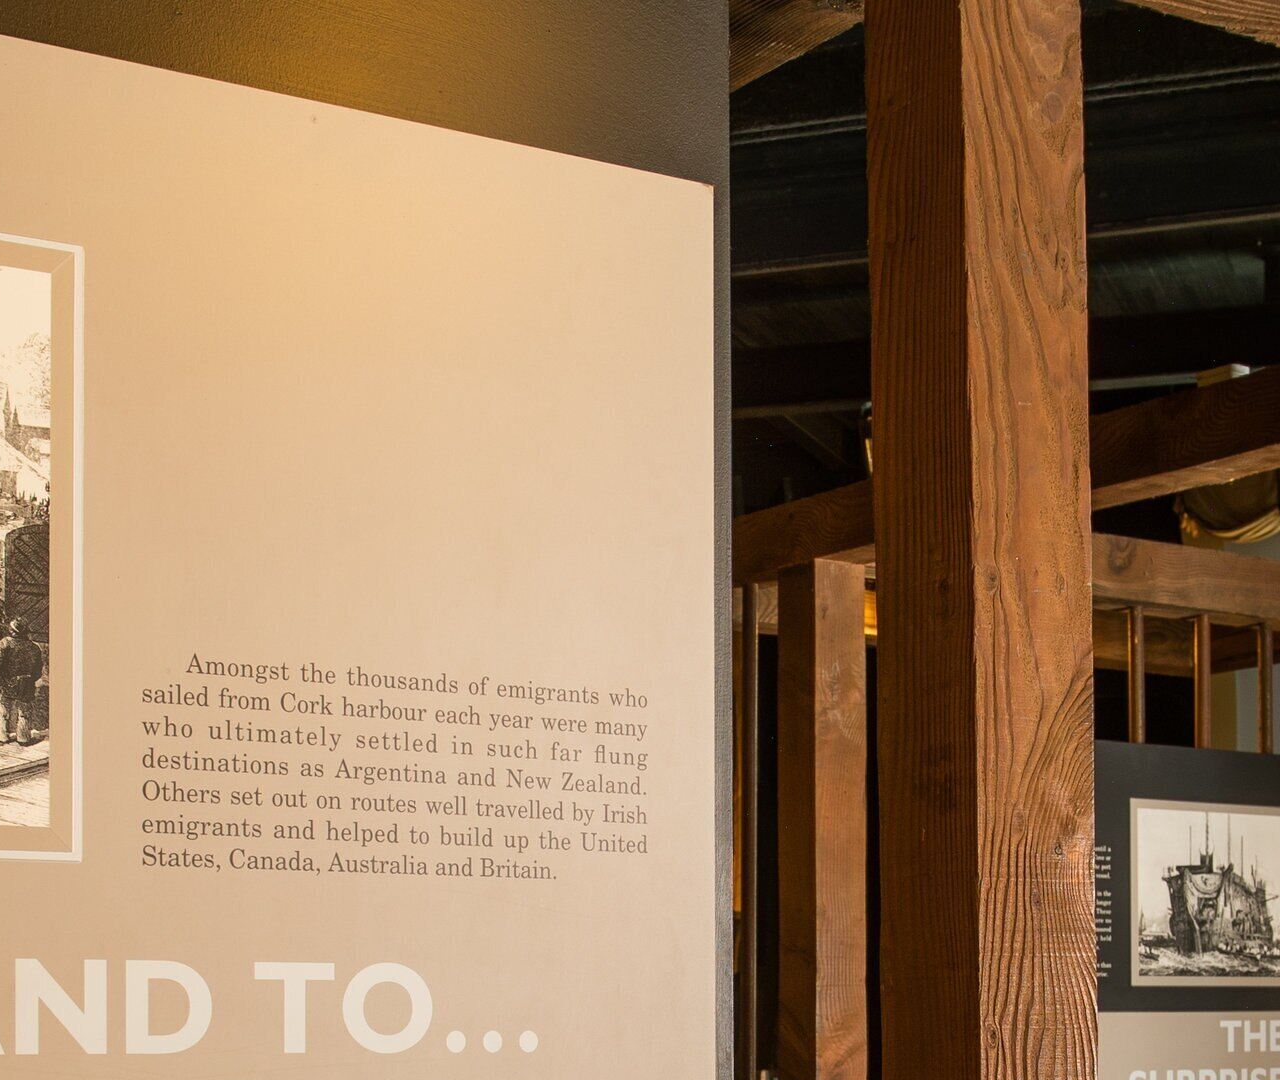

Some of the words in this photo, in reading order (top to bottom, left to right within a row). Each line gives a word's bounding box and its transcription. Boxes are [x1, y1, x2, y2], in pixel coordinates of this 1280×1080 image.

[185, 653, 290, 684] Amongst
[300, 662, 336, 684] the
[347, 666, 458, 694] thousands
[468, 676, 489, 696] of
[497, 681, 599, 705] emigrants
[609, 688, 648, 708] who
[142, 684, 210, 707] sailed
[218, 687, 271, 711] from
[280, 692, 333, 715] Cork
[341, 696, 427, 721] harbour
[435, 705, 481, 726] each
[489, 713, 533, 731] year
[541, 717, 587, 733] were
[595, 721, 648, 742] many
[141, 715, 193, 738] who
[208, 719, 342, 752] ultimately
[356, 731, 438, 753] settled
[451, 735, 473, 755] in
[487, 739, 538, 759] such
[551, 741, 582, 762] far
[594, 744, 648, 771] flung
[142, 747, 289, 776] destinations
[300, 763, 324, 778] as
[334, 758, 447, 785] Argentina
[457, 767, 496, 787] and
[506, 769, 552, 790] New
[562, 772, 646, 795] Zealand.
[142, 779, 221, 804] Others
[230, 787, 263, 806] set
[272, 790, 308, 808] out
[316, 795, 342, 810] on
[350, 794, 417, 813] routes
[425, 795, 467, 816] well
[475, 799, 564, 820] travelled
[572, 802, 595, 826] by
[603, 804, 647, 824] Irish
[142, 814, 262, 840] emigrants
[274, 819, 315, 840] and
[326, 820, 399, 847] helped
[409, 826, 429, 845] to
[440, 825, 493, 847] build
[504, 835, 529, 854] up
[539, 830, 571, 851] the
[580, 832, 648, 854] United
[142, 845, 221, 872] States,
[229, 848, 320, 876] Canada,
[328, 852, 428, 875] Australia
[435, 857, 473, 877] and
[480, 857, 557, 880] Britain.
[254, 962, 538, 1053] TO...
